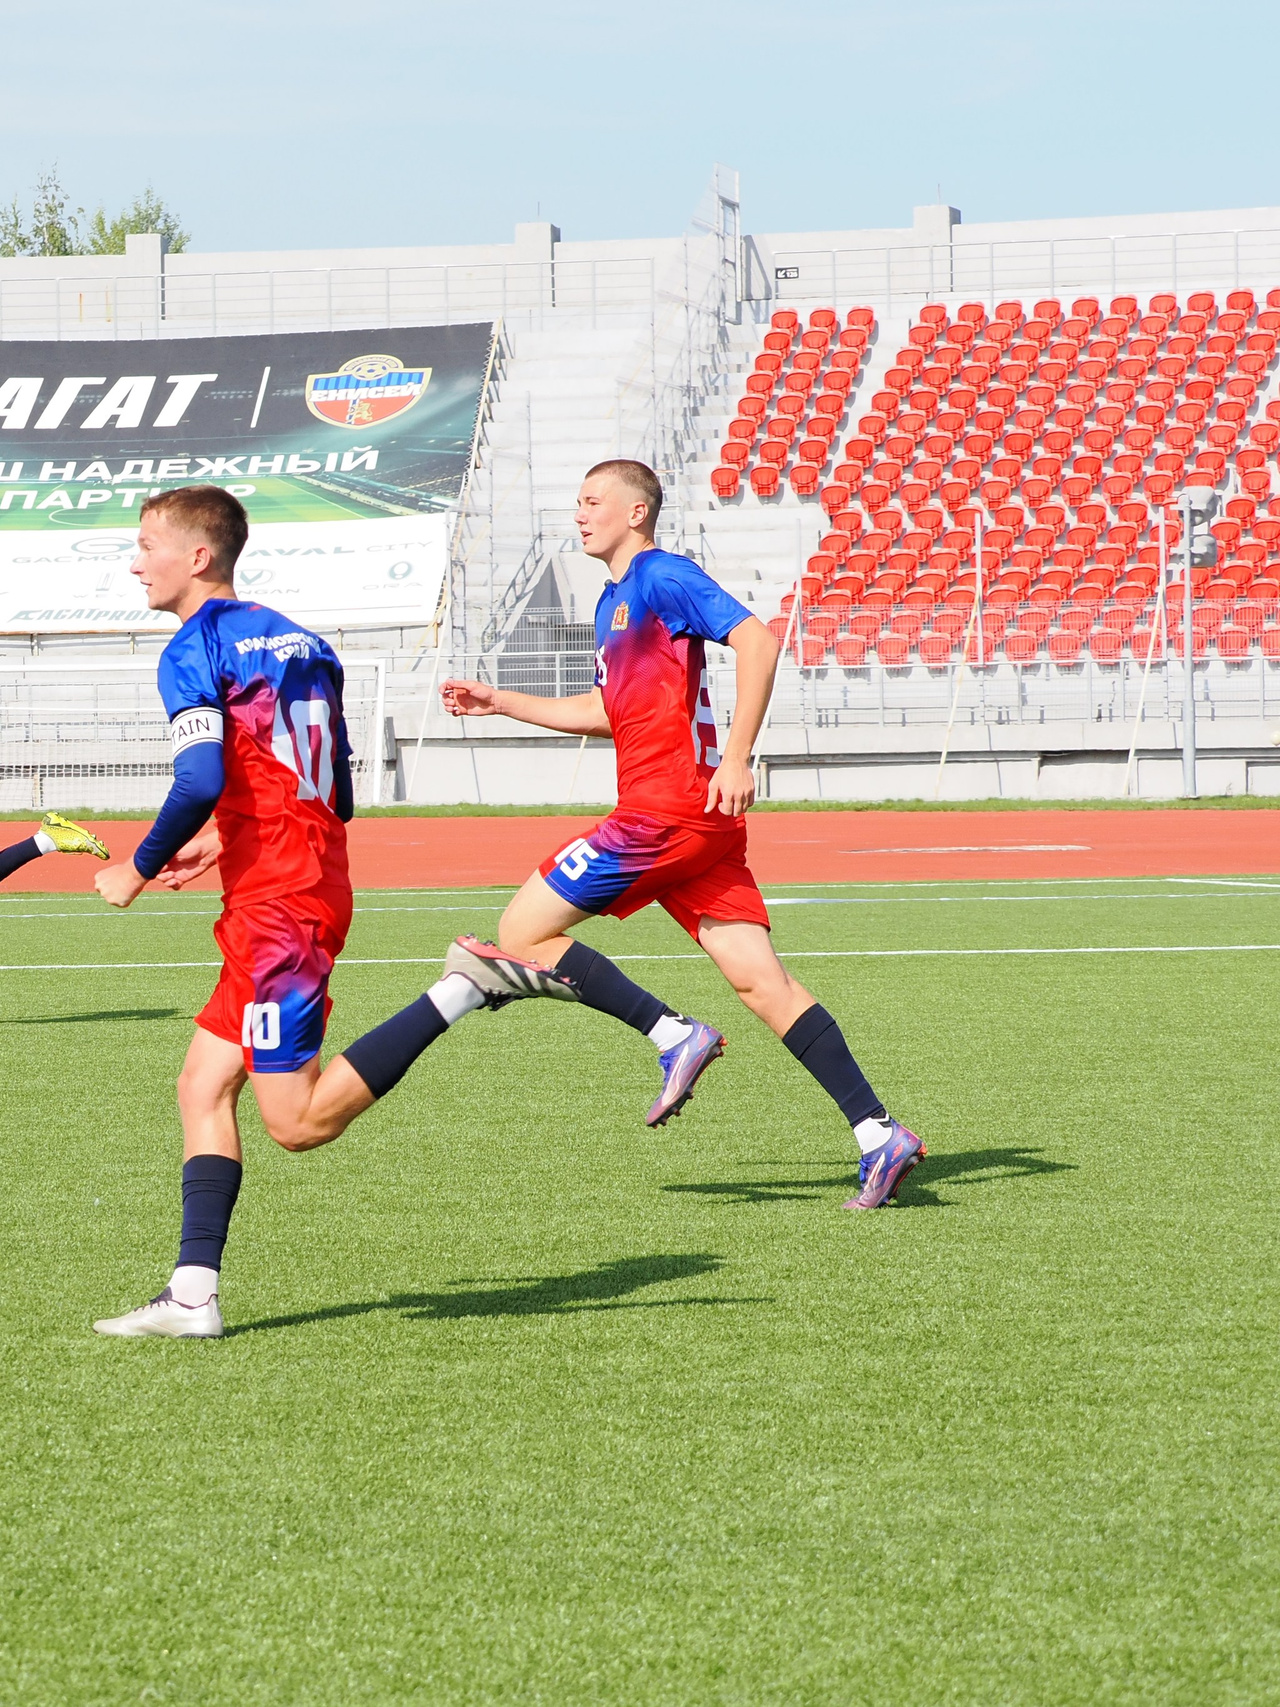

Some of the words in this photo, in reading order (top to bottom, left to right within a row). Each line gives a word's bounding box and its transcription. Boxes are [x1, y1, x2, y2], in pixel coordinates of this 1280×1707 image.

[309, 382, 423, 402] ЕНИСЕЙ
[38, 446, 379, 485] НАДЕЖНЫЙ
[0, 484, 256, 510] ПАРТР
[245, 546, 356, 557] AVAL
[366, 541, 434, 552] CITY
[362, 582, 423, 590] ORA
[171, 716, 210, 745] TAIN
[271, 697, 335, 813] 10
[554, 837, 600, 881] 15
[241, 1001, 281, 1050] 10
